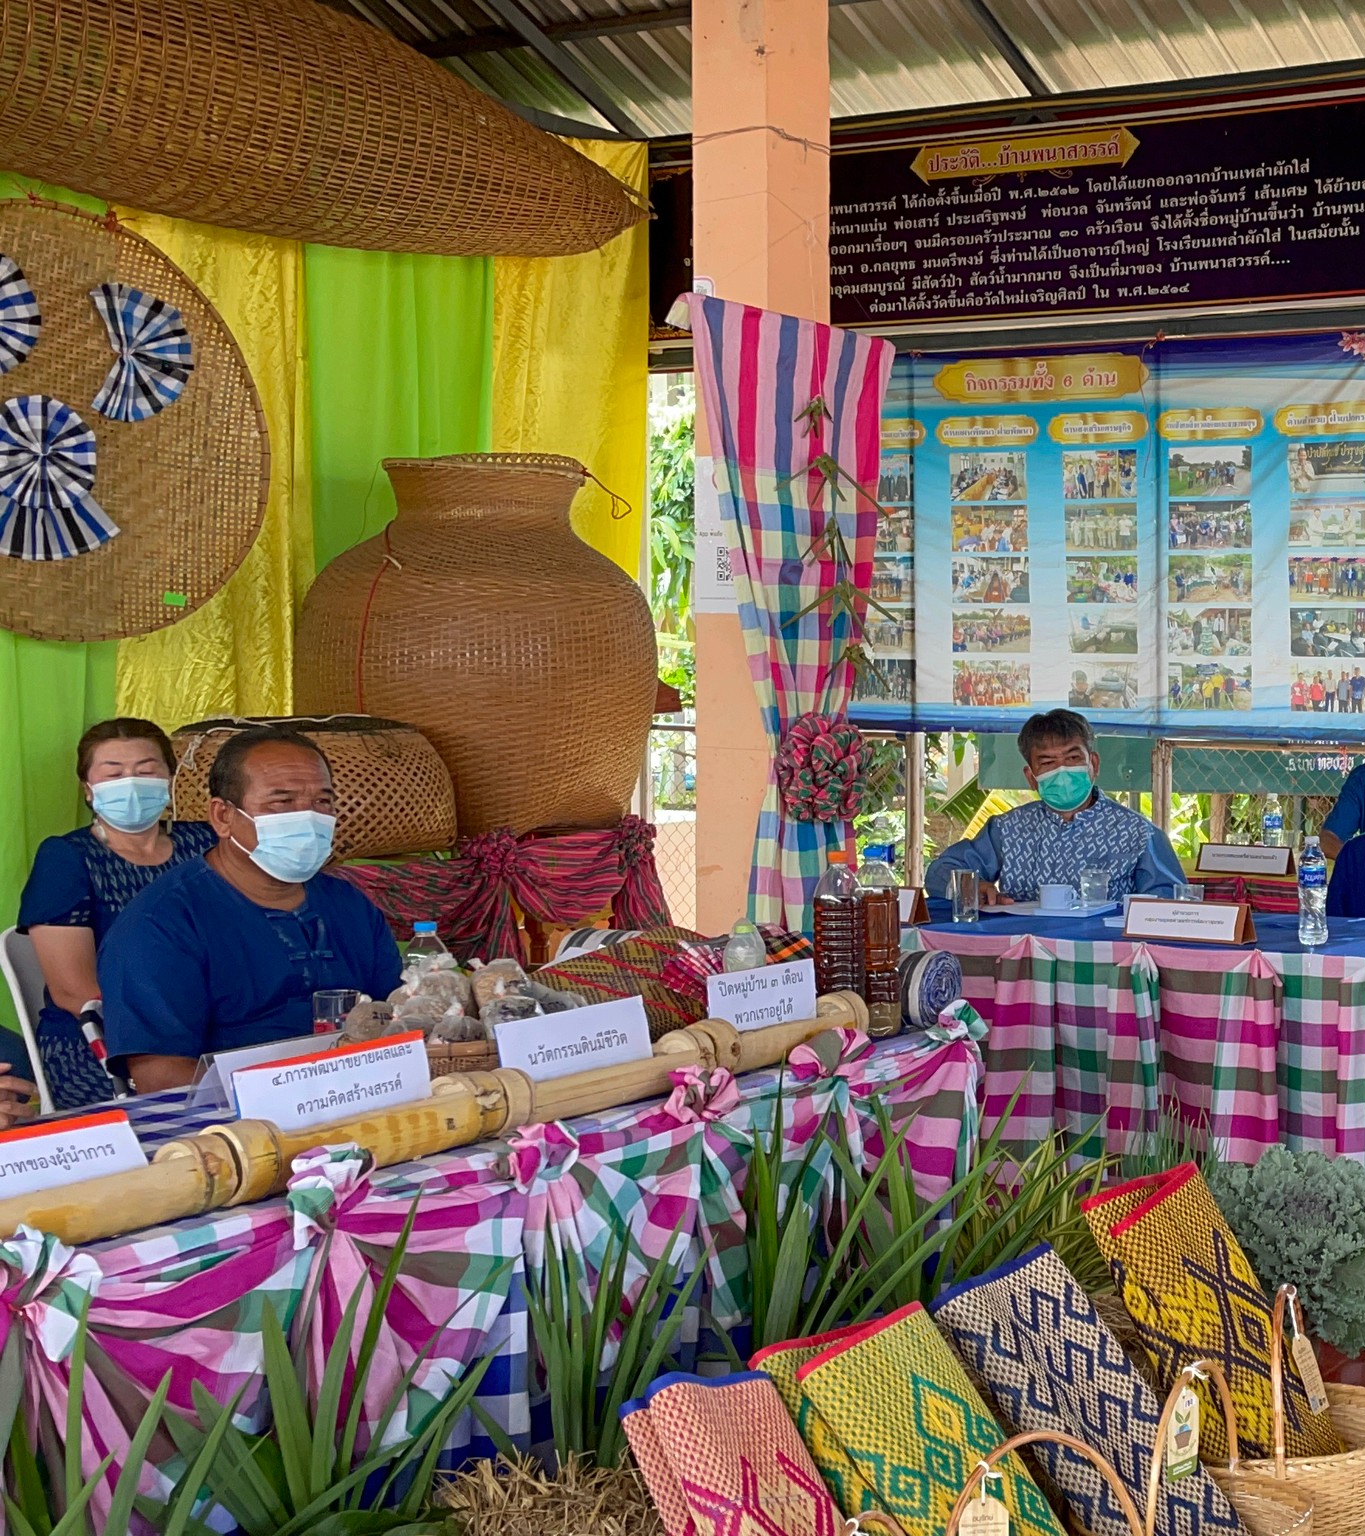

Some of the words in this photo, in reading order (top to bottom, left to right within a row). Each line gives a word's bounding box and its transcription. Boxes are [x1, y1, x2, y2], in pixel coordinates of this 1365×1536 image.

[894, 212, 939, 231] พ่อเสาร์
[947, 206, 1026, 227] ประเสริฐพงษ์
[1041, 201, 1088, 218] พ่อนวล
[1096, 195, 1151, 214] จันทรัตน์
[1160, 186, 1246, 209] และพ่อจันทร์
[902, 186, 1001, 210] ได้ก่อตั้งขึ้นเมื่อปี
[1009, 184, 1080, 200] พ.ศ.๒๕๑๒
[830, 234, 907, 255] ออกมาเรื่อยๆ
[914, 228, 1051, 249] จนมีครอบครัวประมาณ
[1059, 228, 1079, 238] ๓๐
[1086, 219, 1143, 237] ครัวเรือน
[1150, 201, 1304, 231] จึงได้ตั้งชื่อหมู่บ้านขึ้นว่า
[923, 253, 983, 270] มนตรีพงษ์
[990, 238, 1150, 267] ซึ่งท่านได้เป็นอาจารย์ใหญ่
[1156, 227, 1281, 252] โรงเรียนเหล่าผักใส่
[1288, 217, 1360, 241] ในสมัยนั้น
[912, 274, 962, 290] มีสัตว์ป่า
[970, 266, 1062, 287] สัตว์น้ำมากมาย
[1069, 258, 1162, 279] จึงเป็นที่มาของ
[869, 284, 1086, 313] ต่อมาได้ตั้งวัดขึ้นคือวัดใหม่เจริญศิลป์
[1093, 284, 1109, 299] ใน
[965, 363, 1054, 392] กิจกรรมทั้ง
[1063, 376, 1072, 388] 6
[1082, 368, 1117, 387] ด้าน
[718, 975, 768, 999] ปิดหมู่บ้าน
[770, 979, 778, 987] ๓
[781, 970, 804, 986] เดือน
[735, 1001, 794, 1024] พวกเราอยู่ได้
[528, 1029, 628, 1066] นวัตกรรมดินมีชีวิต
[296, 1072, 403, 1116] ความคิดสร้างสรรค์
